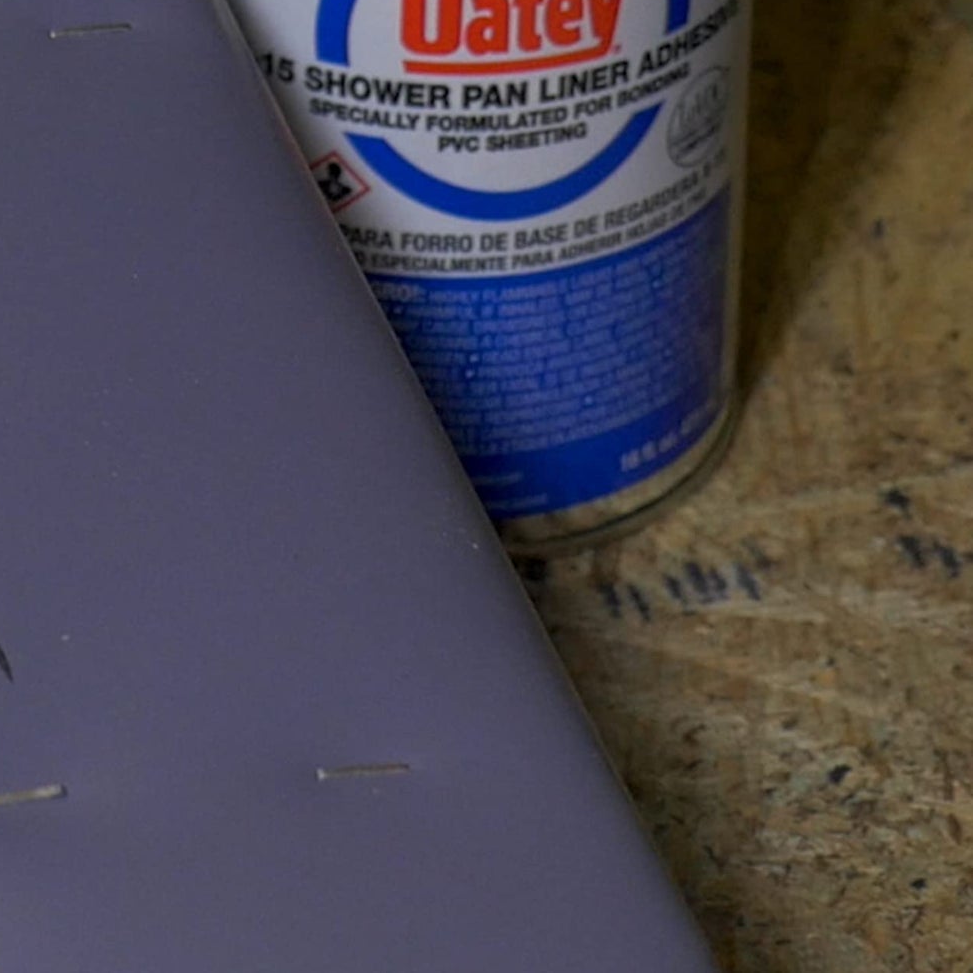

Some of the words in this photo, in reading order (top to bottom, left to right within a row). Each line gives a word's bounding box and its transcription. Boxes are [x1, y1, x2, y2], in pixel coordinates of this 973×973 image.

[304, 65, 451, 109] SHOWER
[462, 80, 528, 109] PAN
[540, 60, 630, 104] LINER
[308, 98, 421, 131] SPECIALLY
[426, 105, 568, 133] FORMULATED
[573, 94, 613, 119] FOR
[438, 134, 479, 154] PVC
[484, 121, 588, 153] SHEETING
[400, 232, 473, 253] FORRO
[479, 230, 509, 253] DE
[514, 223, 569, 250] BASE
[573, 214, 600, 238] DE
[370, 253, 509, 272] ESPECIALMENTE
[512, 246, 555, 266] PARA
